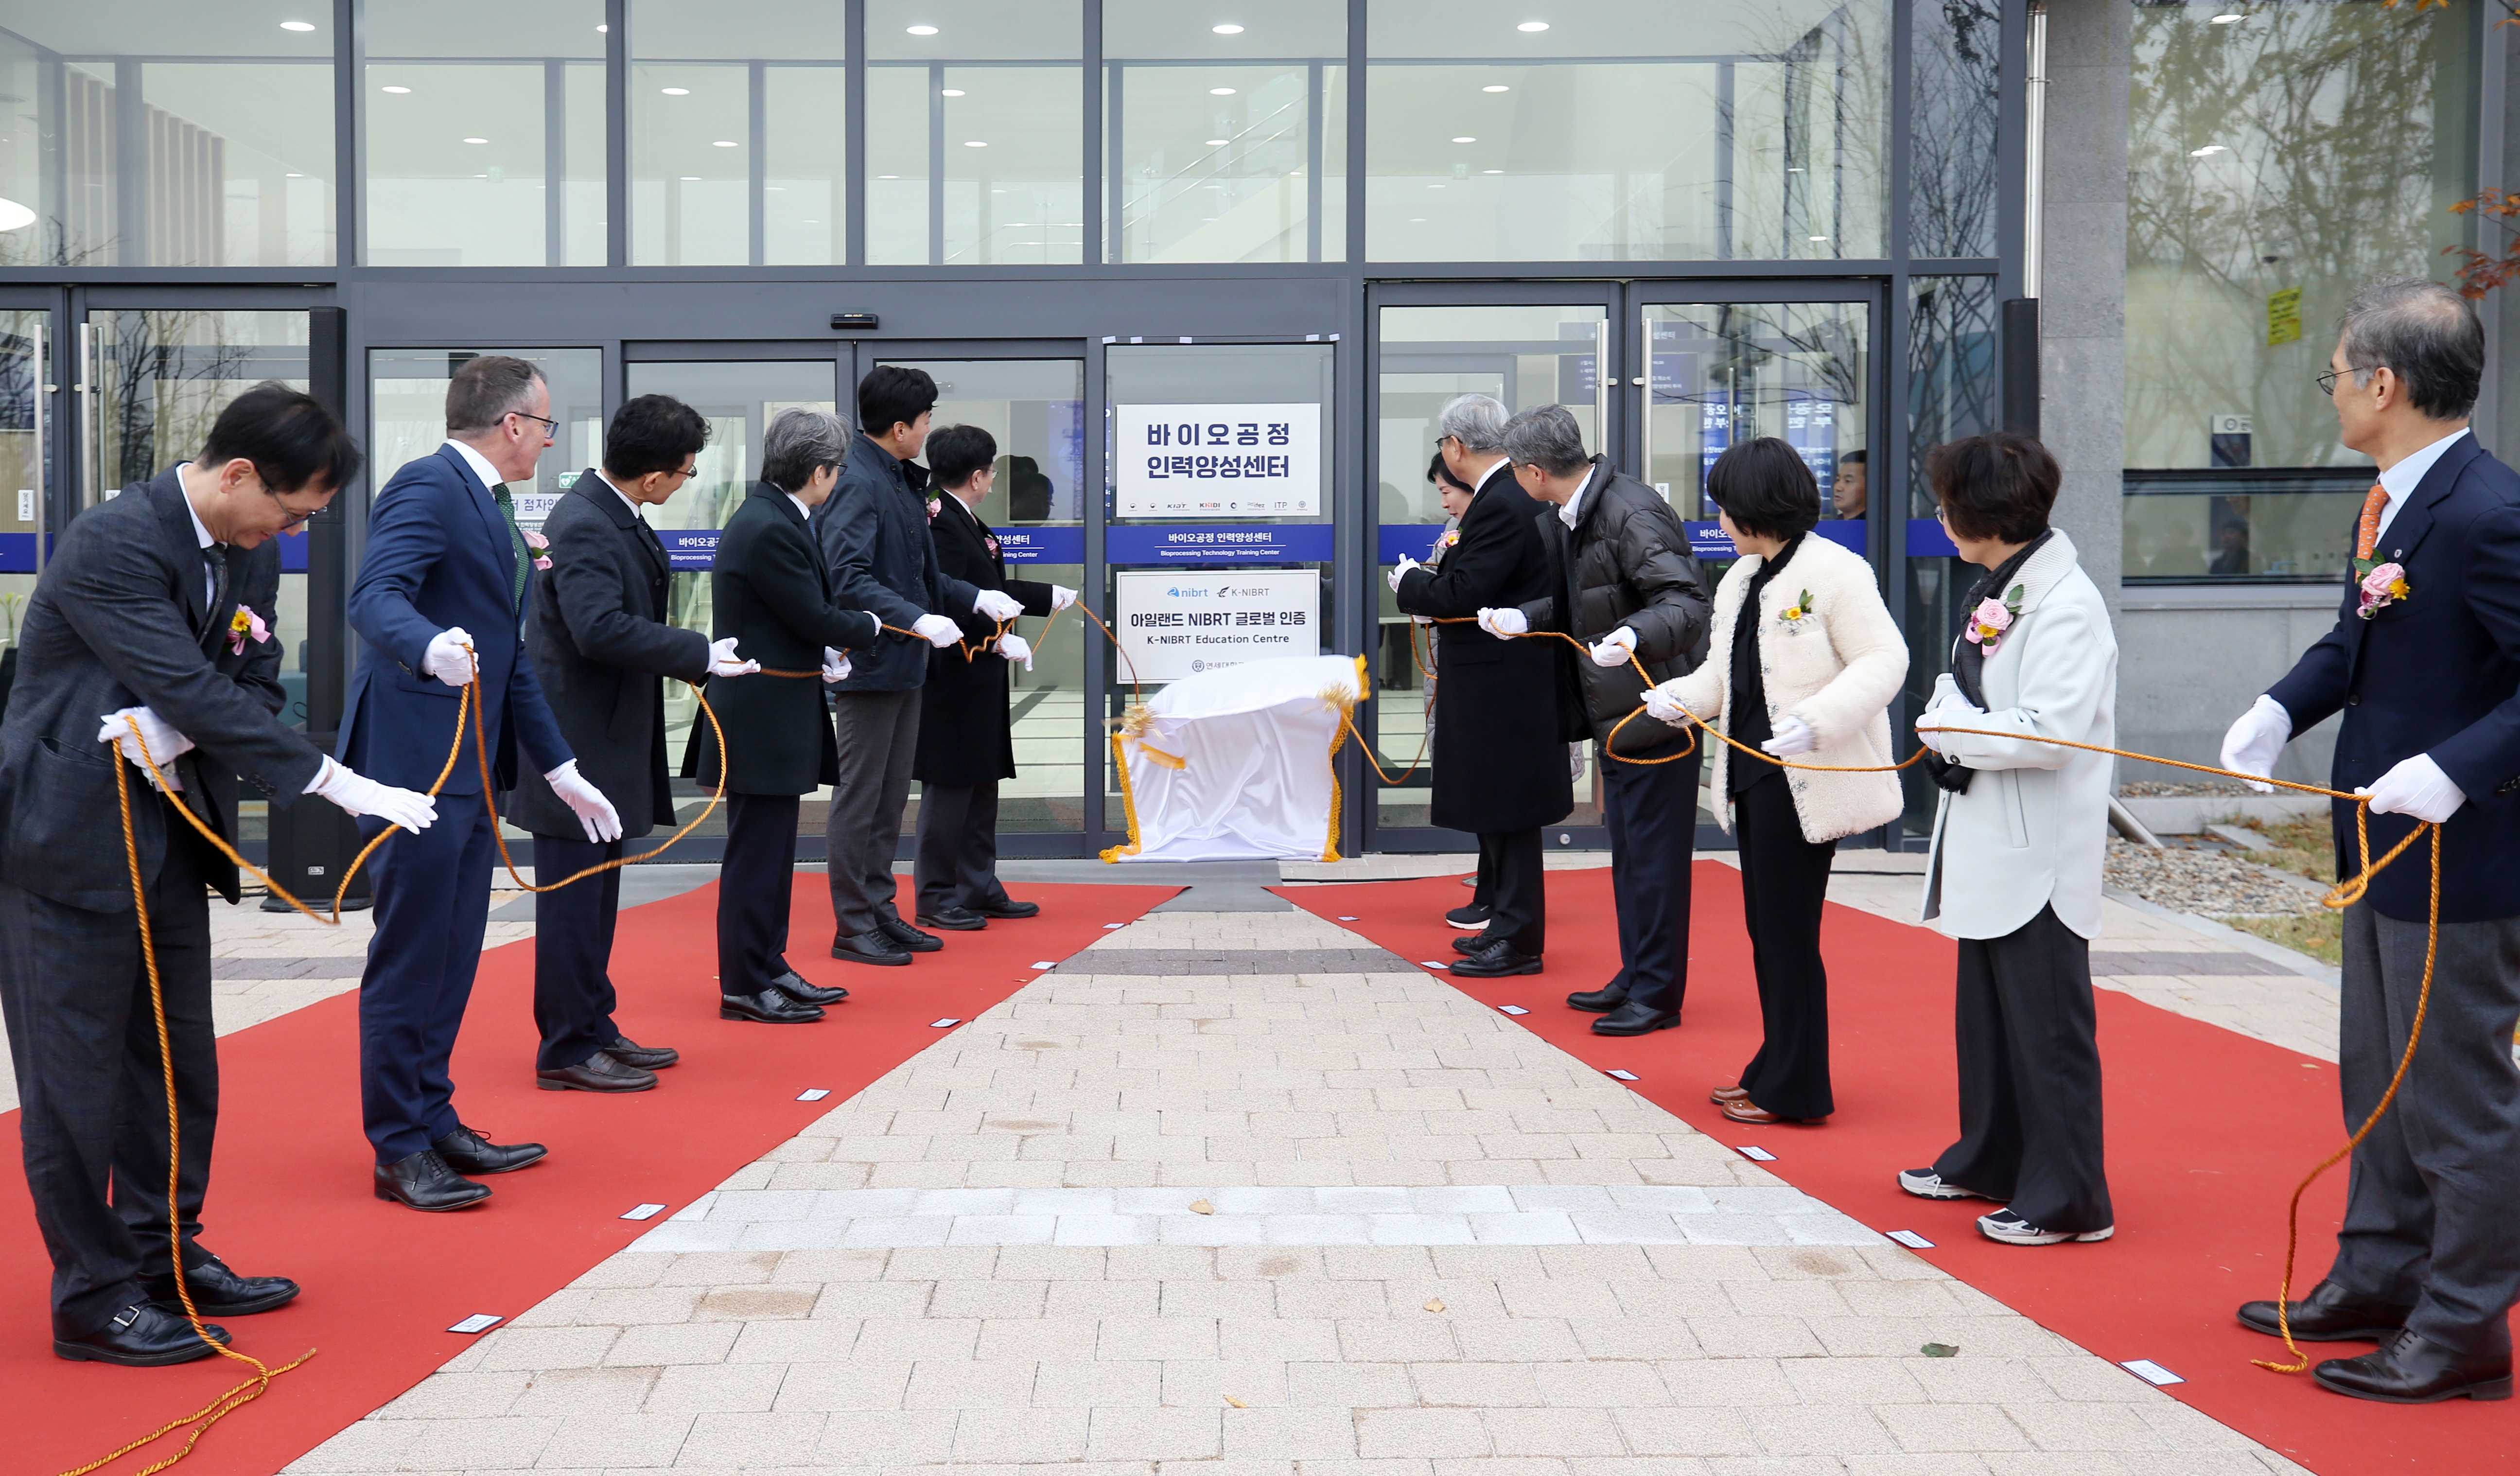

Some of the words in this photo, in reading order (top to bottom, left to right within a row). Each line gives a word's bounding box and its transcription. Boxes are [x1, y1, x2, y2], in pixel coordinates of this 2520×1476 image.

[1147, 422, 1289, 446] 바이오공정
[1147, 455, 1289, 479] 인력양성센터
[1168, 532, 1214, 544] 바이오공정
[1216, 532, 1272, 543] 인력양성센터
[1699, 529, 1733, 539] 바이오
[1181, 588, 1209, 597] nibrt
[1231, 588, 1270, 597] K-NIBRT
[1131, 613, 1184, 627] 아일랜드
[1188, 612, 1232, 626] NIBRT
[1235, 611, 1276, 626] 글로벌
[1279, 611, 1306, 626] 인증
[1147, 635, 1192, 645] K-NIBRT
[1195, 634, 1249, 644] Education
[1252, 634, 1290, 643] Centre
